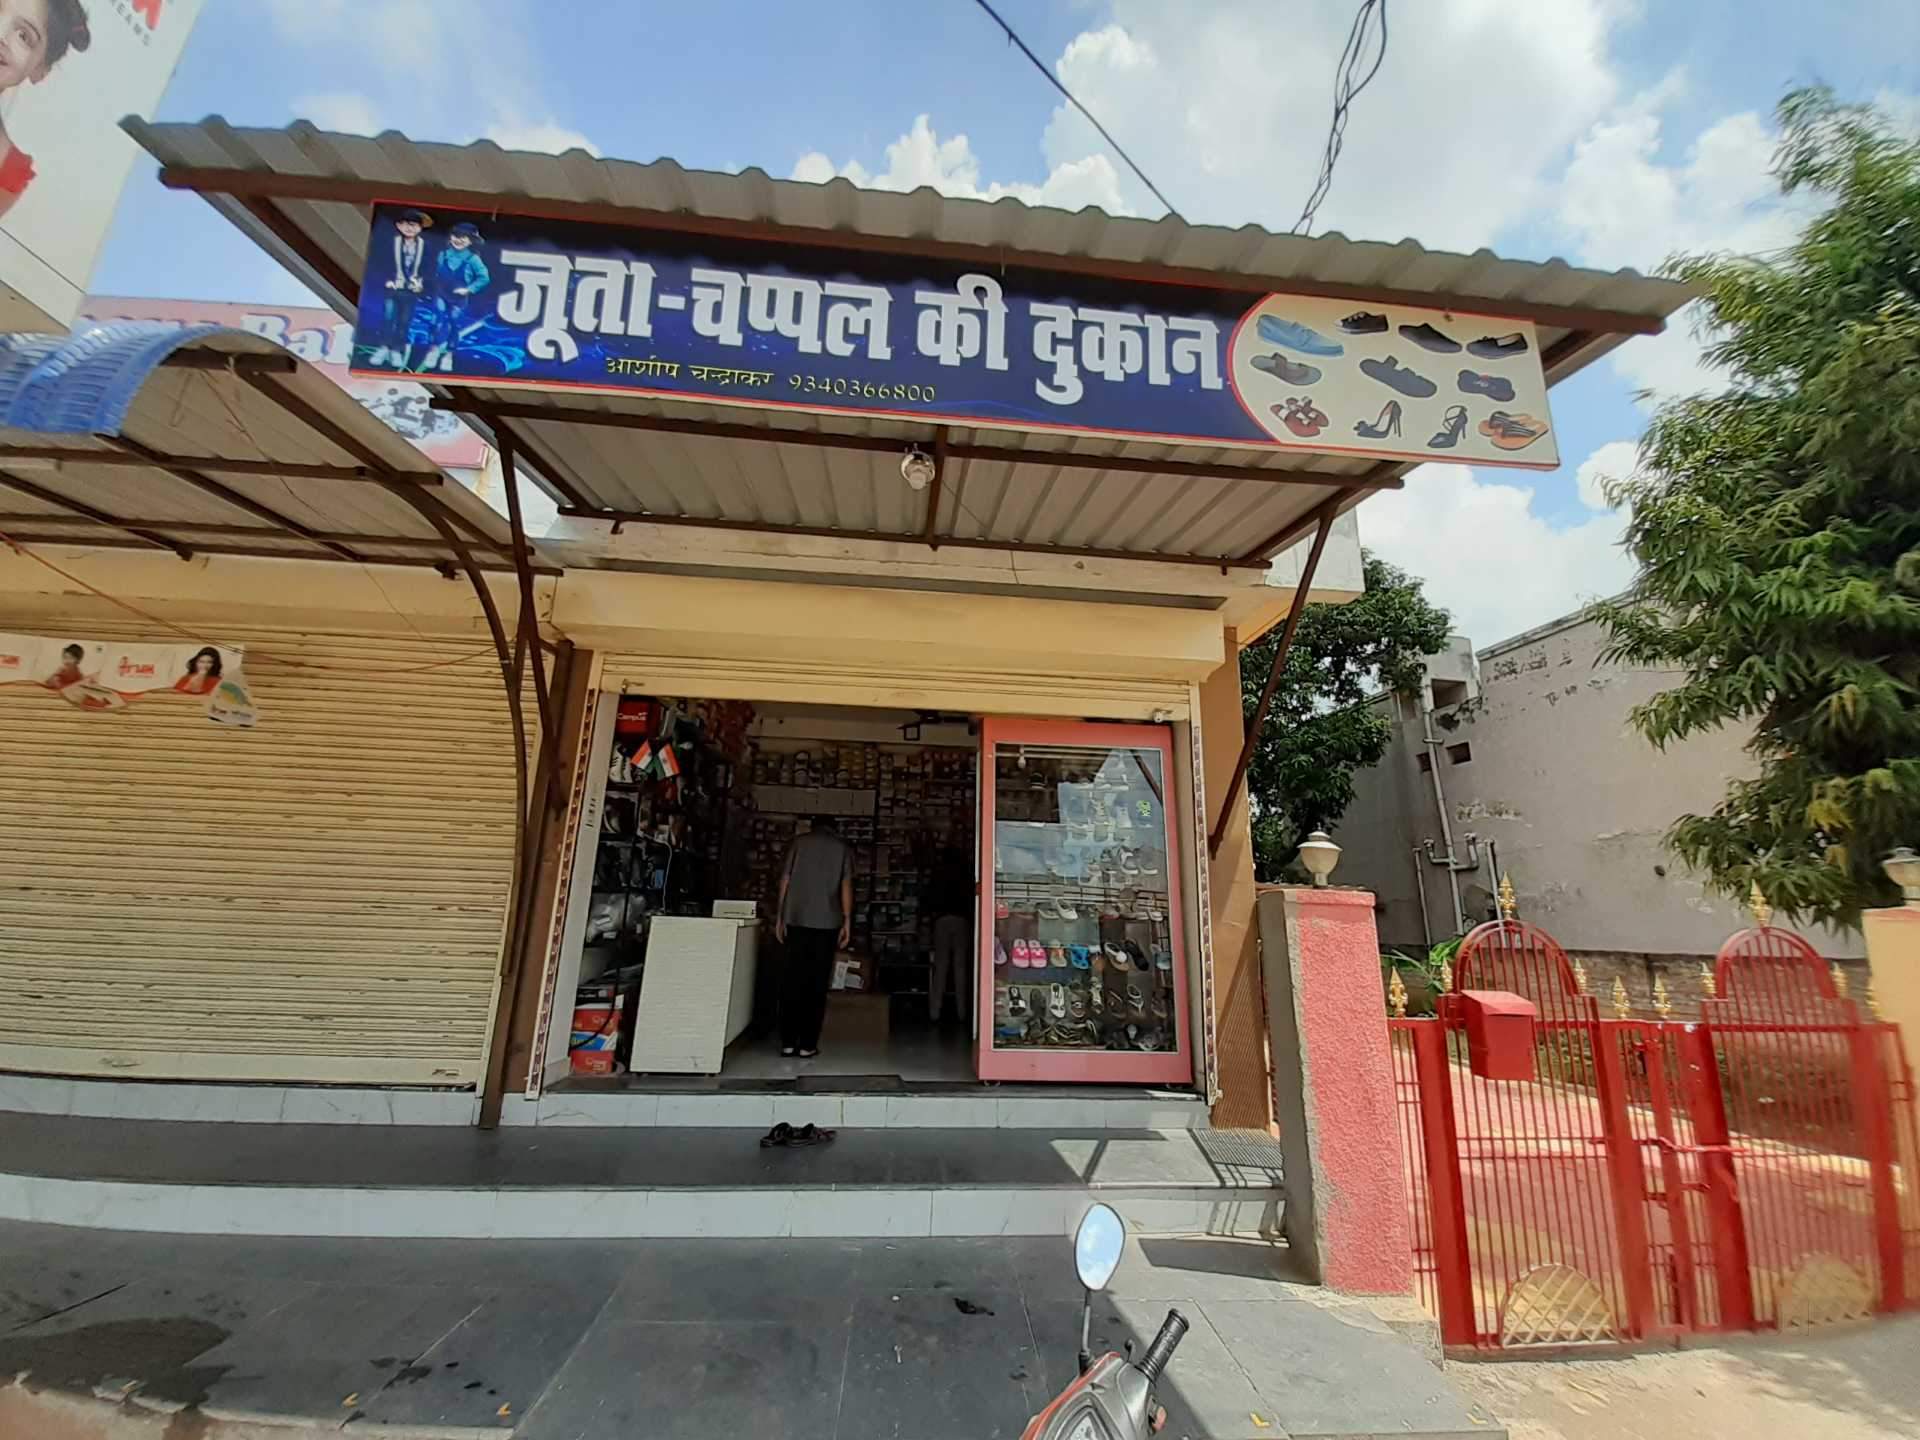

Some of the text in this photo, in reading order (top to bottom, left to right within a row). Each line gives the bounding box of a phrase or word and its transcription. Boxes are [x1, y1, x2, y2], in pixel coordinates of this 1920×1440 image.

[914, 273, 1009, 371] की
[1029, 302, 1224, 405] दुकान
[788, 373, 935, 403] 9340366800
